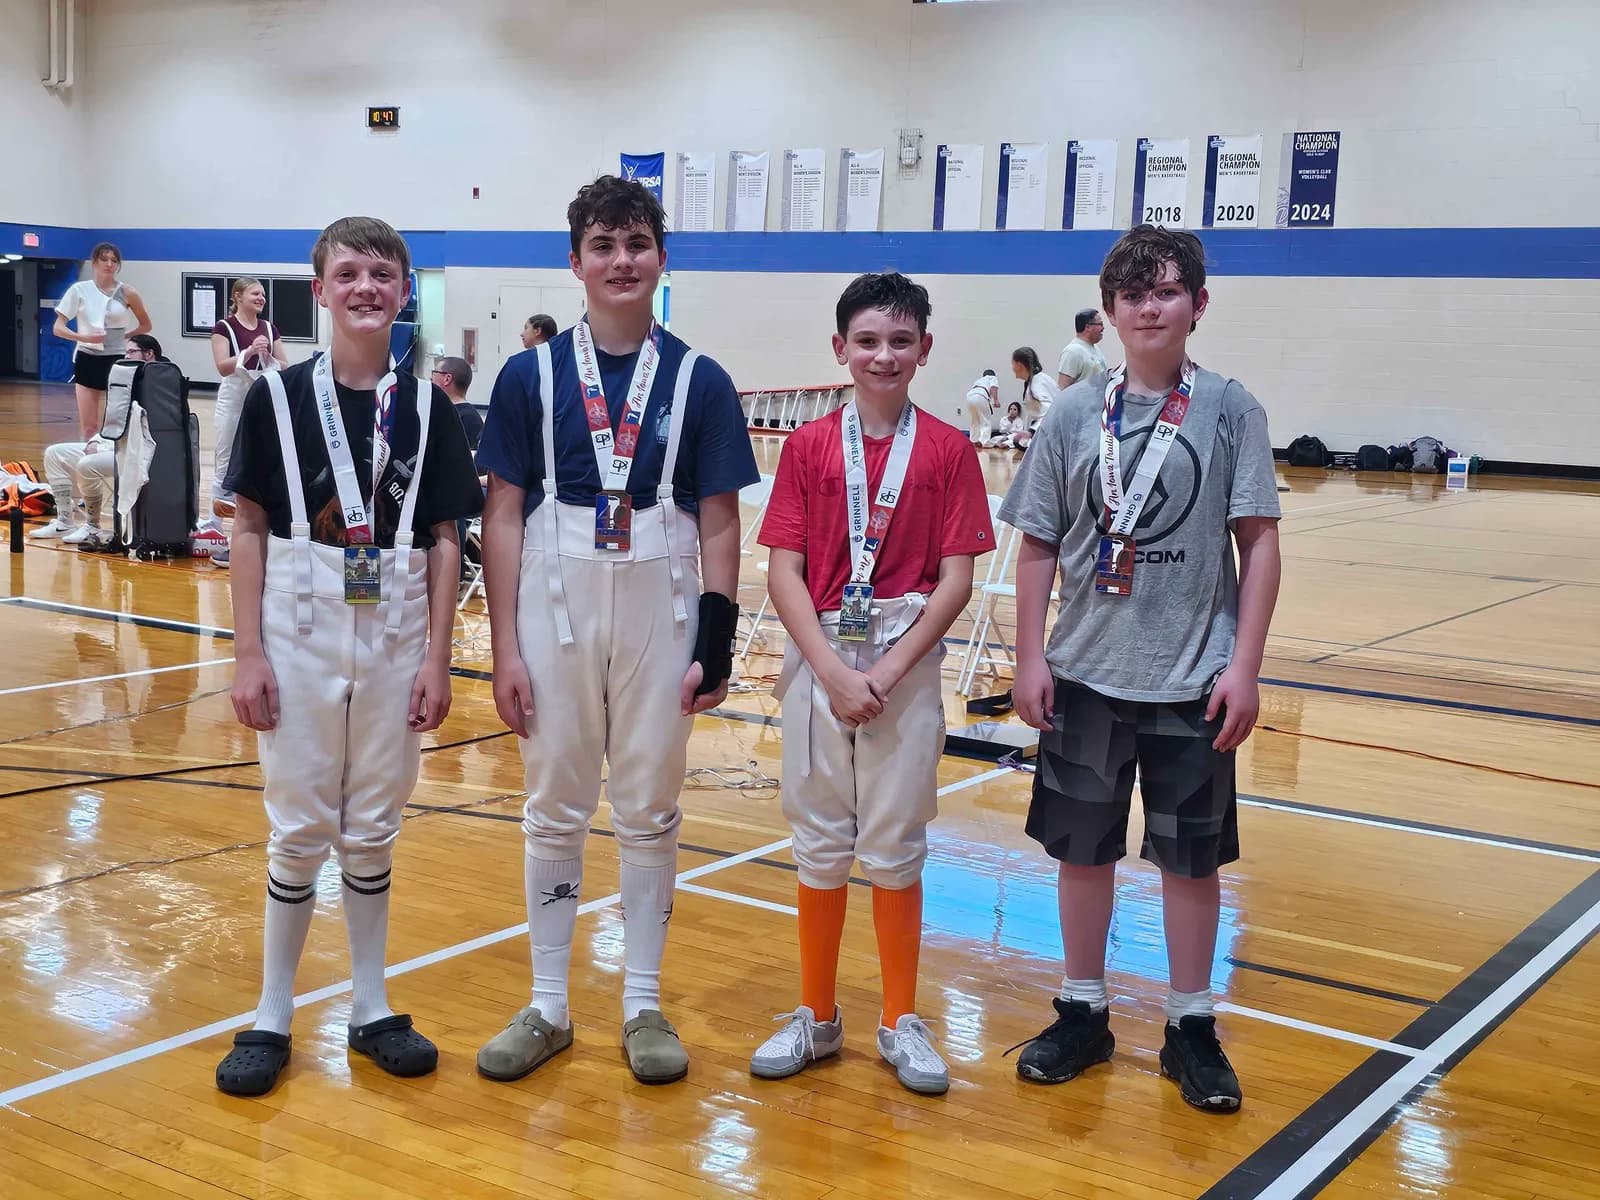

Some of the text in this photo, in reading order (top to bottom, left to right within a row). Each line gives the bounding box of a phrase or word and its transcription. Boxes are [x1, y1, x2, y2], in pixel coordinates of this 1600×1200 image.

[1295, 141, 1338, 150] CHAMPION
[1297, 133, 1336, 142] NATIONAL
[1148, 156, 1184, 164] REGIONAL
[1219, 153, 1257, 161] REGIONAL
[1219, 161, 1261, 169] CHAMPION
[1145, 206, 1182, 222] 2018
[1217, 205, 1255, 221] 2020
[1291, 203, 1331, 221] 2024
[322, 391, 338, 437] GRINNELL
[849, 424, 860, 464] GRINNELL
[1106, 464, 1117, 487] Iowa
[852, 485, 861, 531] GRINNELL
[1118, 504, 1136, 533] GRINN
